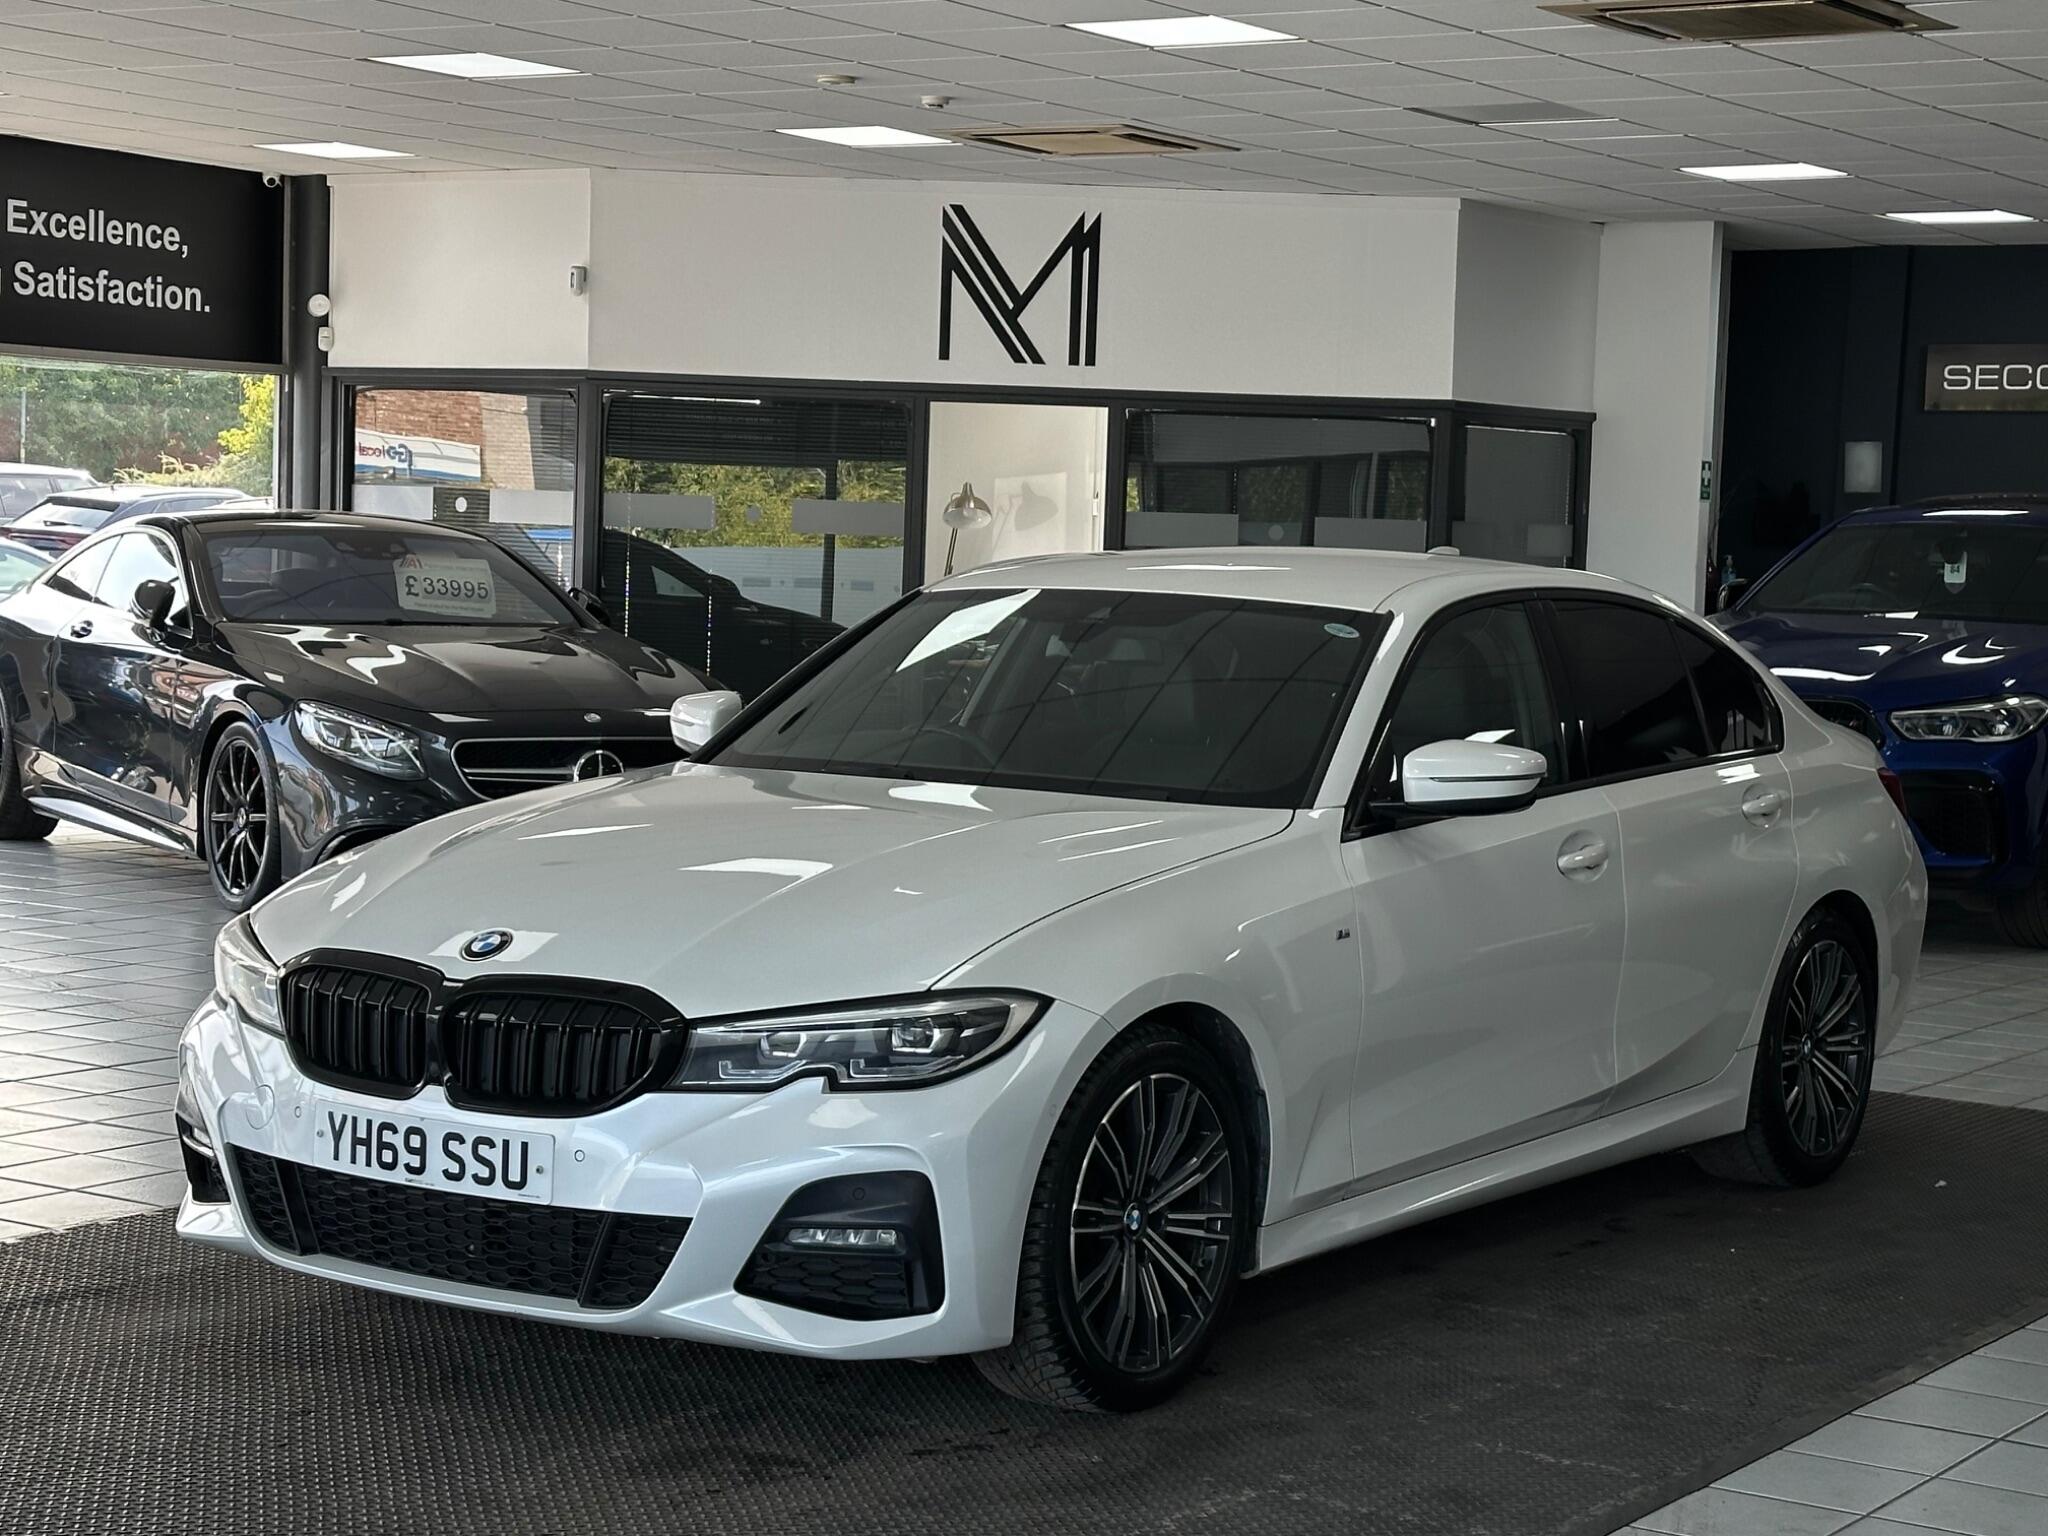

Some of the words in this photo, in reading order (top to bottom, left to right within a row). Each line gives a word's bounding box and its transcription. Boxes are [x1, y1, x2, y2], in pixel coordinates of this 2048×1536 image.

[6, 198, 189, 259] Excellence,
[13, 260, 211, 313] Satisfaction.
[404, 575, 489, 599] £33995
[327, 1110, 427, 1176] YH69
[441, 1131, 529, 1191] SSU
